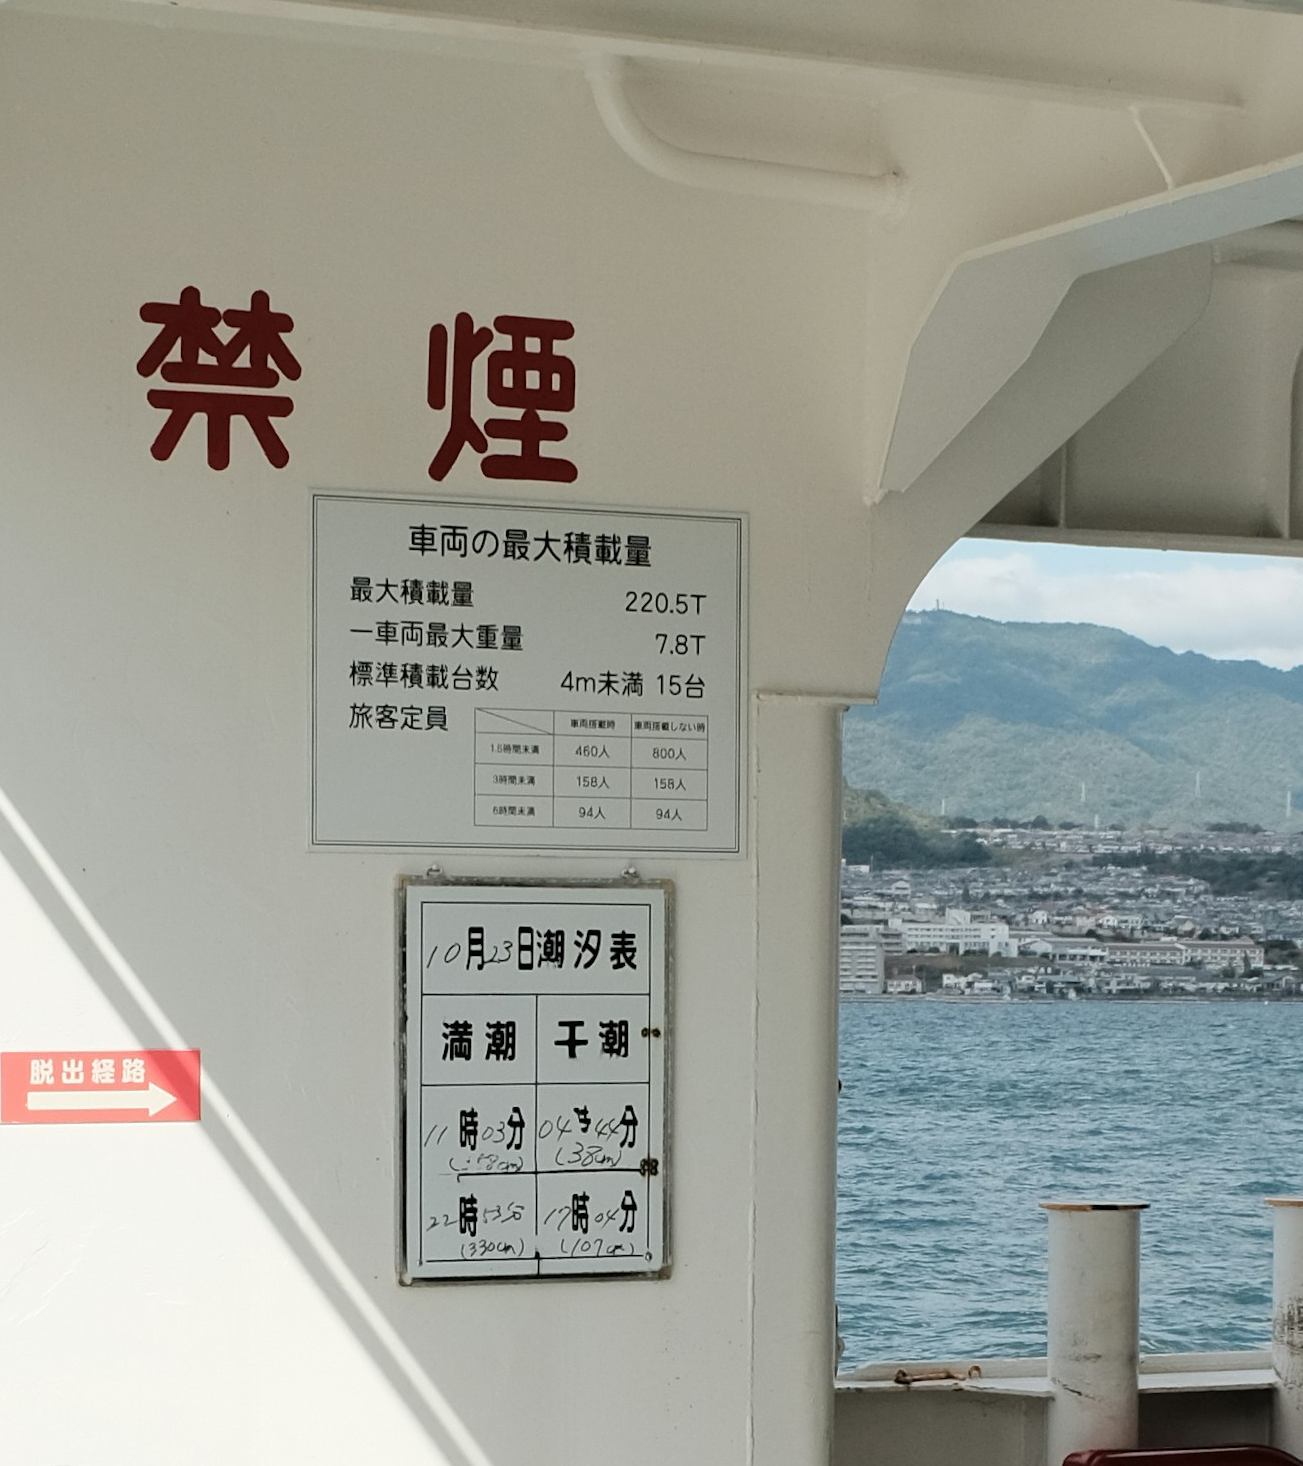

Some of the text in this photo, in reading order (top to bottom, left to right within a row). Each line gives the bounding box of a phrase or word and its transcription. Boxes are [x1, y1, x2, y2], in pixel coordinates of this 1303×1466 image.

[137, 285, 579, 484] 禁煙
[408, 522, 653, 568] 車両の最大積載量
[349, 575, 708, 616] 最大積載量 220.5T
[349, 619, 707, 656] 一車両最大重量 7.8T
[348, 659, 707, 699] 標準積載台数 4m未満 15台
[348, 702, 449, 732] 旅客定員
[576, 775, 611, 790] 158人
[578, 806, 607, 821] 94人
[655, 808, 683, 823] 94人
[441, 1020, 516, 1062] 満潮
[553, 1020, 629, 1060] 干潮
[29, 1058, 146, 1085] 脱出経路
